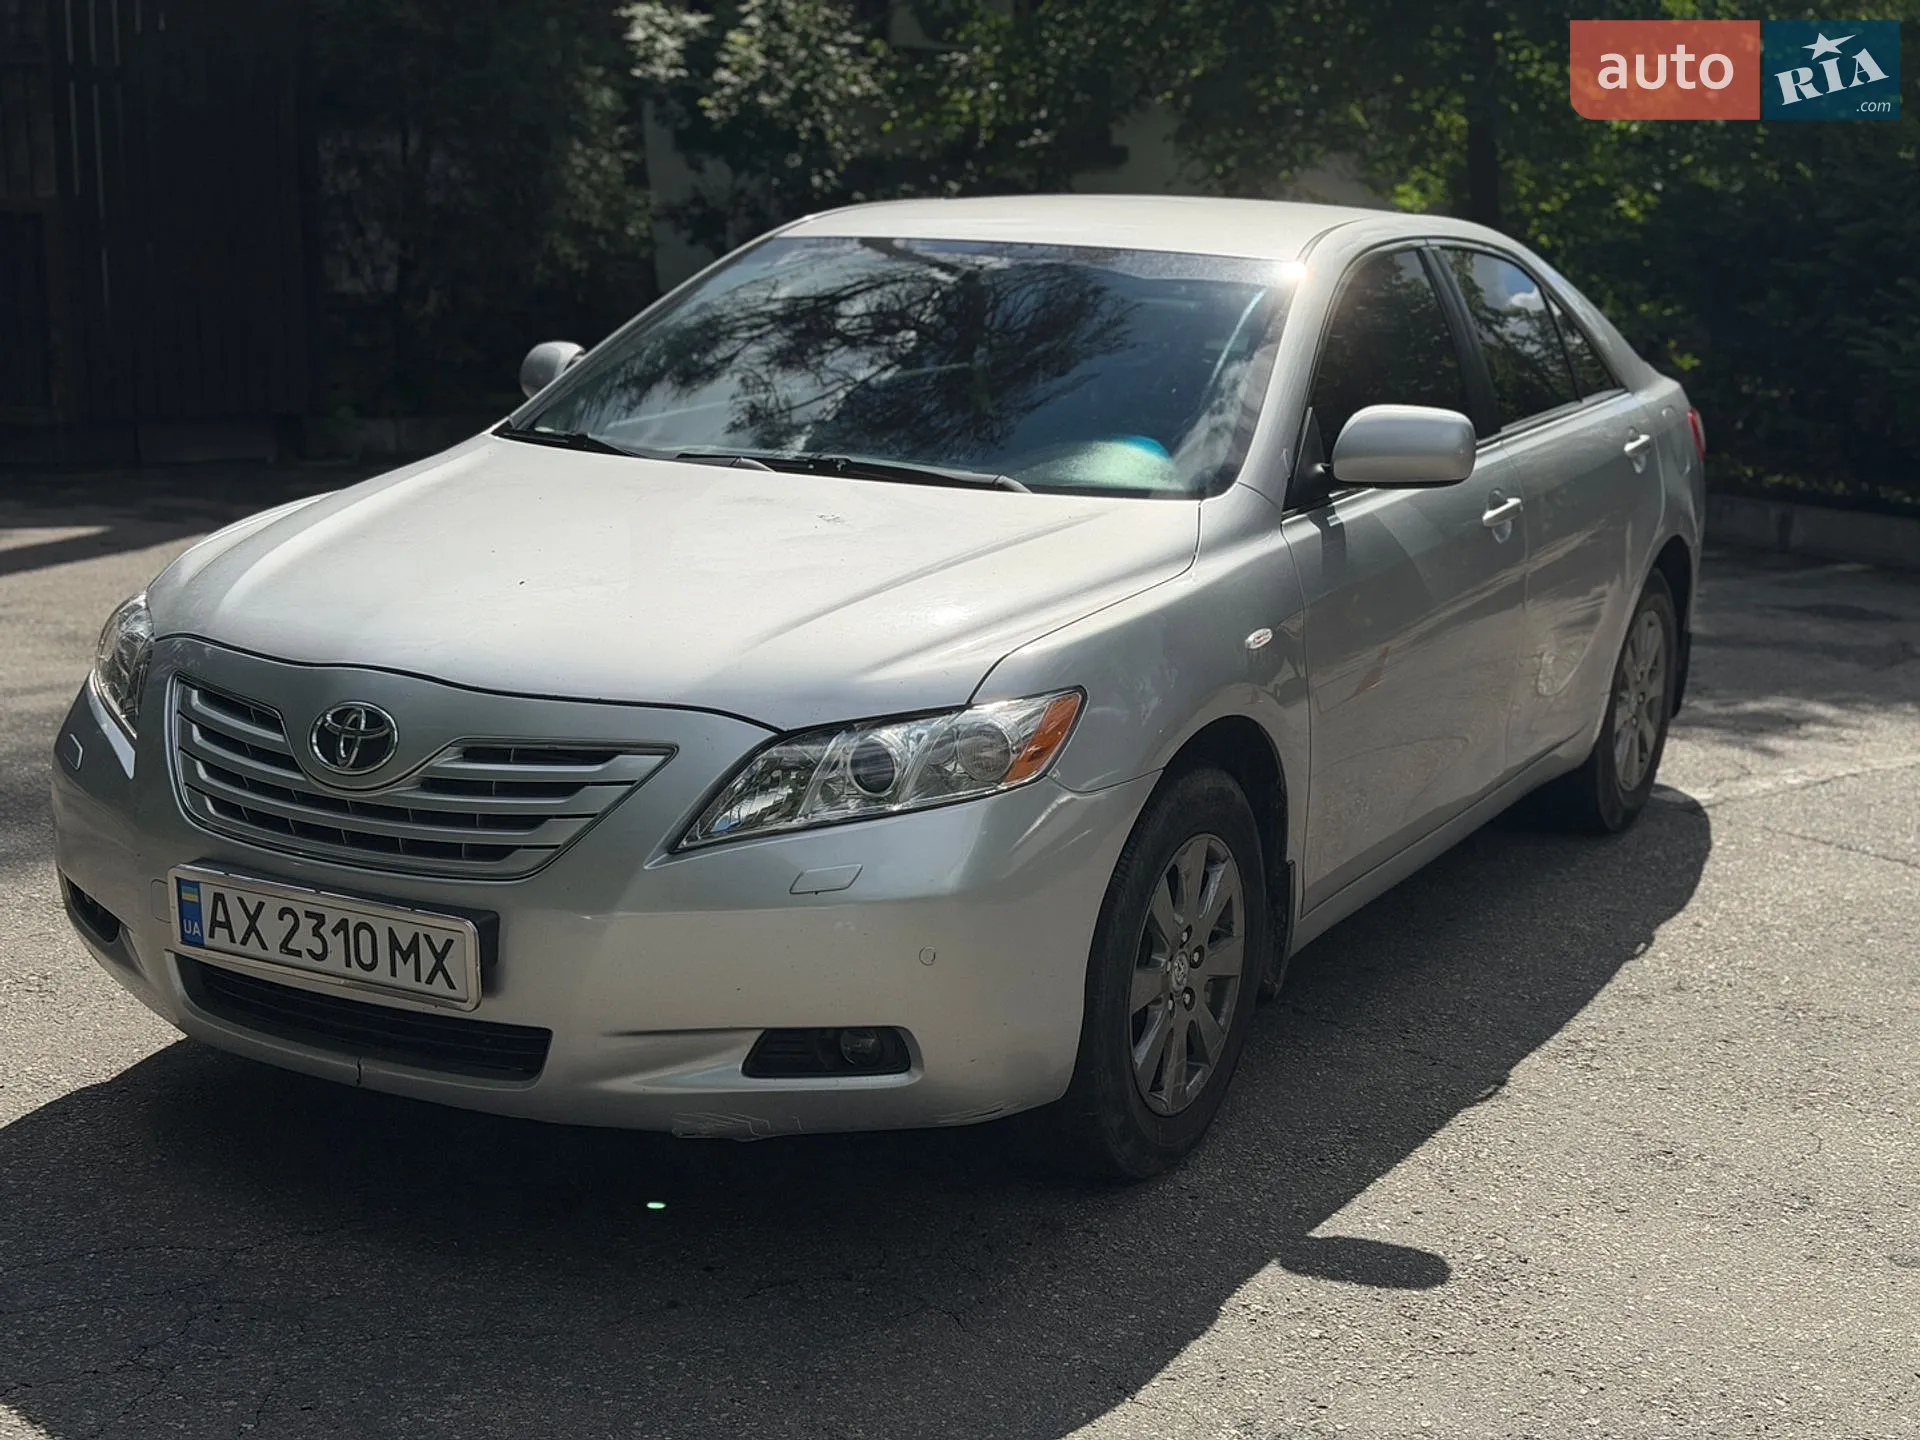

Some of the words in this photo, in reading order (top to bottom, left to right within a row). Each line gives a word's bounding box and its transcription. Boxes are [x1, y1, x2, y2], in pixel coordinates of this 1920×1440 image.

[183, 919, 202, 937] UA
[208, 891, 269, 951] AX
[278, 906, 378, 972] 2310
[388, 926, 456, 990] MX
